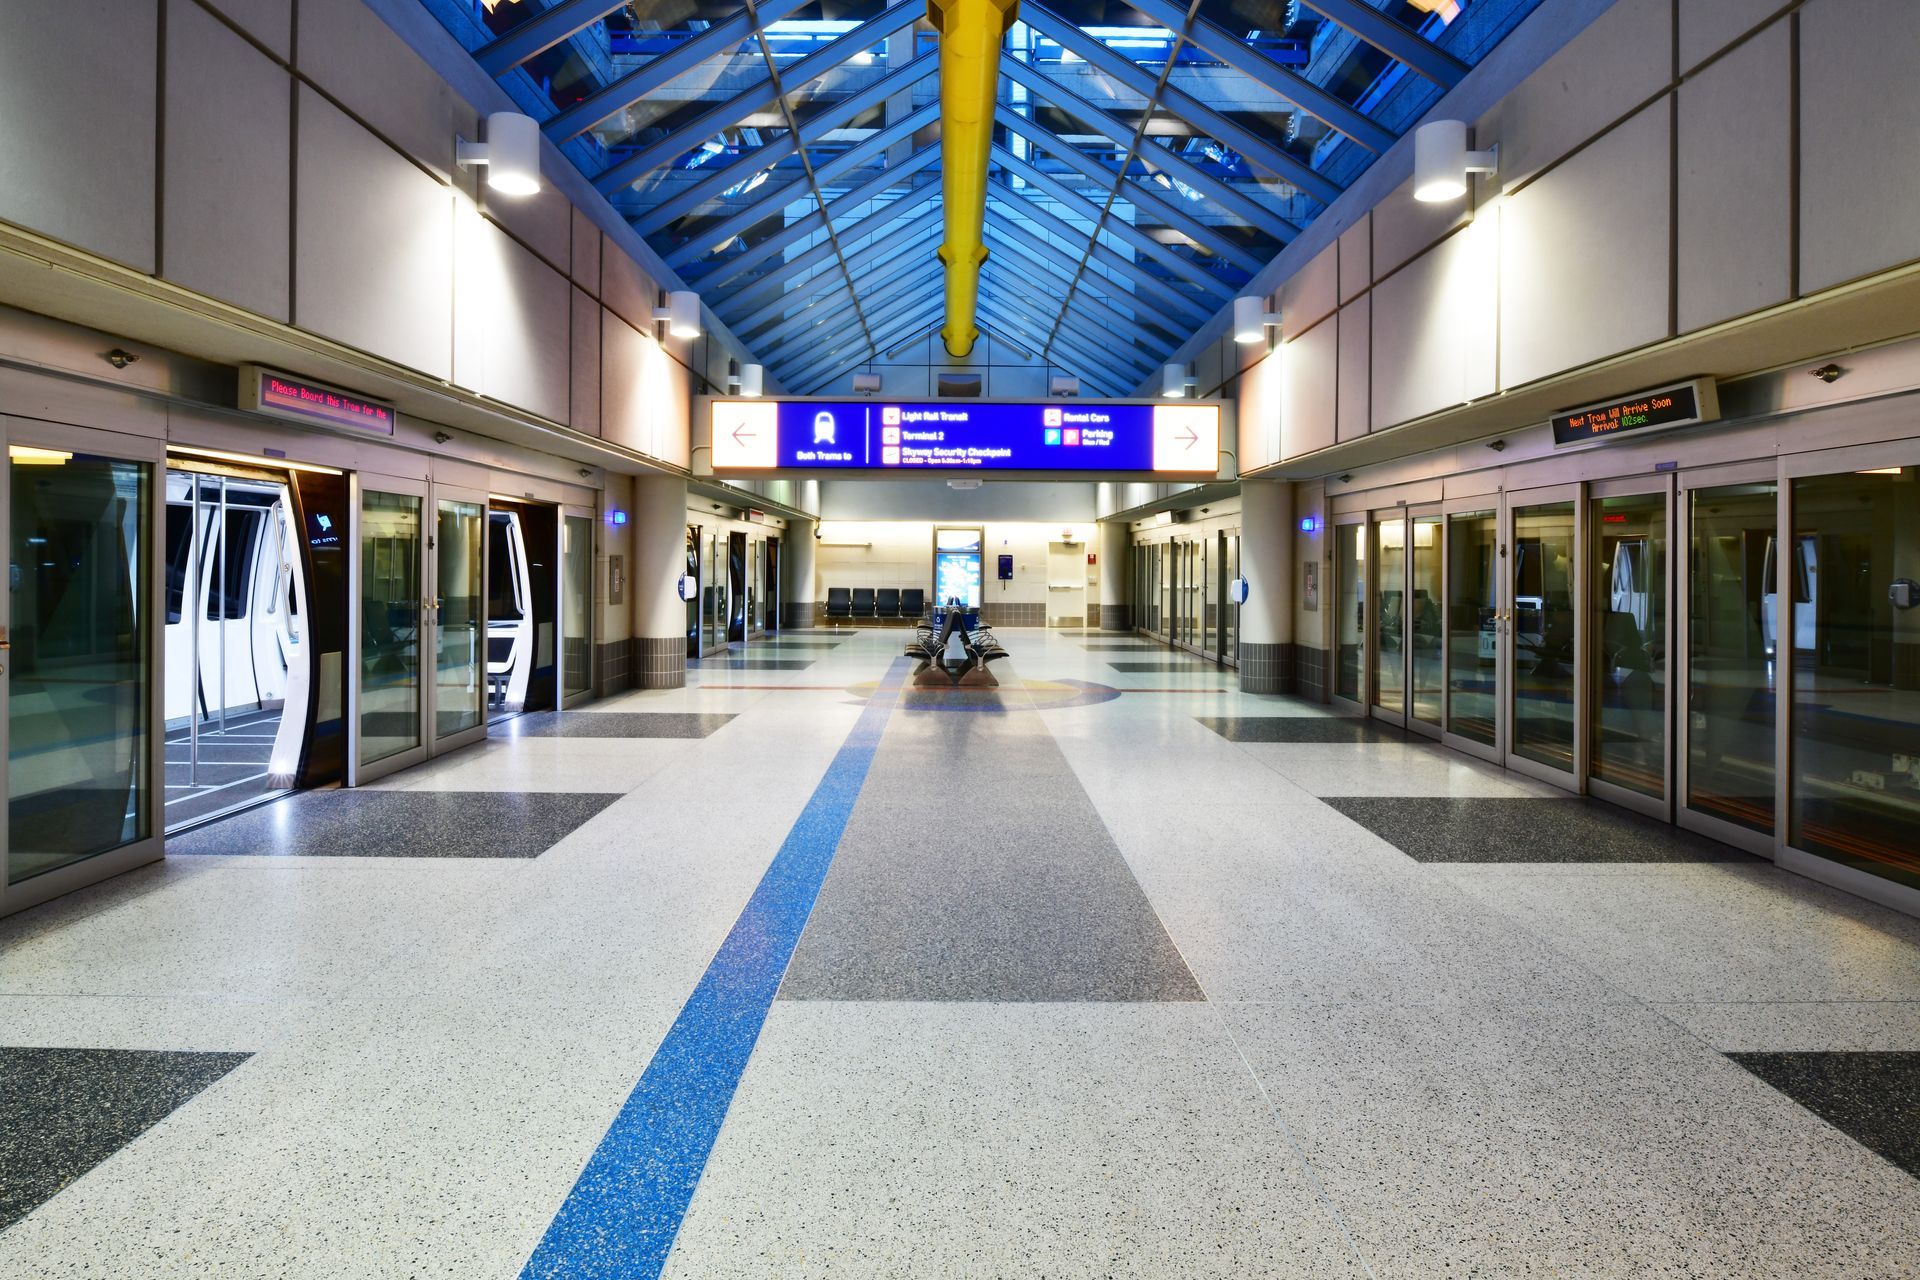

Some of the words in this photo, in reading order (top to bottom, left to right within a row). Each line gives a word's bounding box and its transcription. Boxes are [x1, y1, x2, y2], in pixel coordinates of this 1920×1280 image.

[271, 380, 297, 397] Please
[301, 388, 323, 403] Board
[327, 395, 339, 407] this
[343, 400, 360, 412] Tram
[363, 405, 373, 416] for
[376, 409, 386, 419] the
[902, 411, 923, 423] Light
[923, 411, 940, 421] Rail
[940, 411, 968, 421] Transit
[1063, 412, 1090, 422] Rental
[1090, 412, 1110, 422] Cars
[1569, 416, 1584, 428] Next
[1587, 412, 1607, 423] Tram
[1608, 407, 1620, 419] Will
[1623, 403, 1648, 416] Arrive
[1651, 398, 1671, 409] Soon
[902, 430, 938, 441] Terminal
[938, 431, 945, 441] 2
[1082, 428, 1114, 440] Parking
[796, 450, 816, 460] Both
[816, 451, 843, 461] Trams
[843, 452, 853, 461] to
[901, 447, 933, 458] Skyway
[933, 447, 967, 458] Security
[967, 447, 1011, 459] Checkpoint
